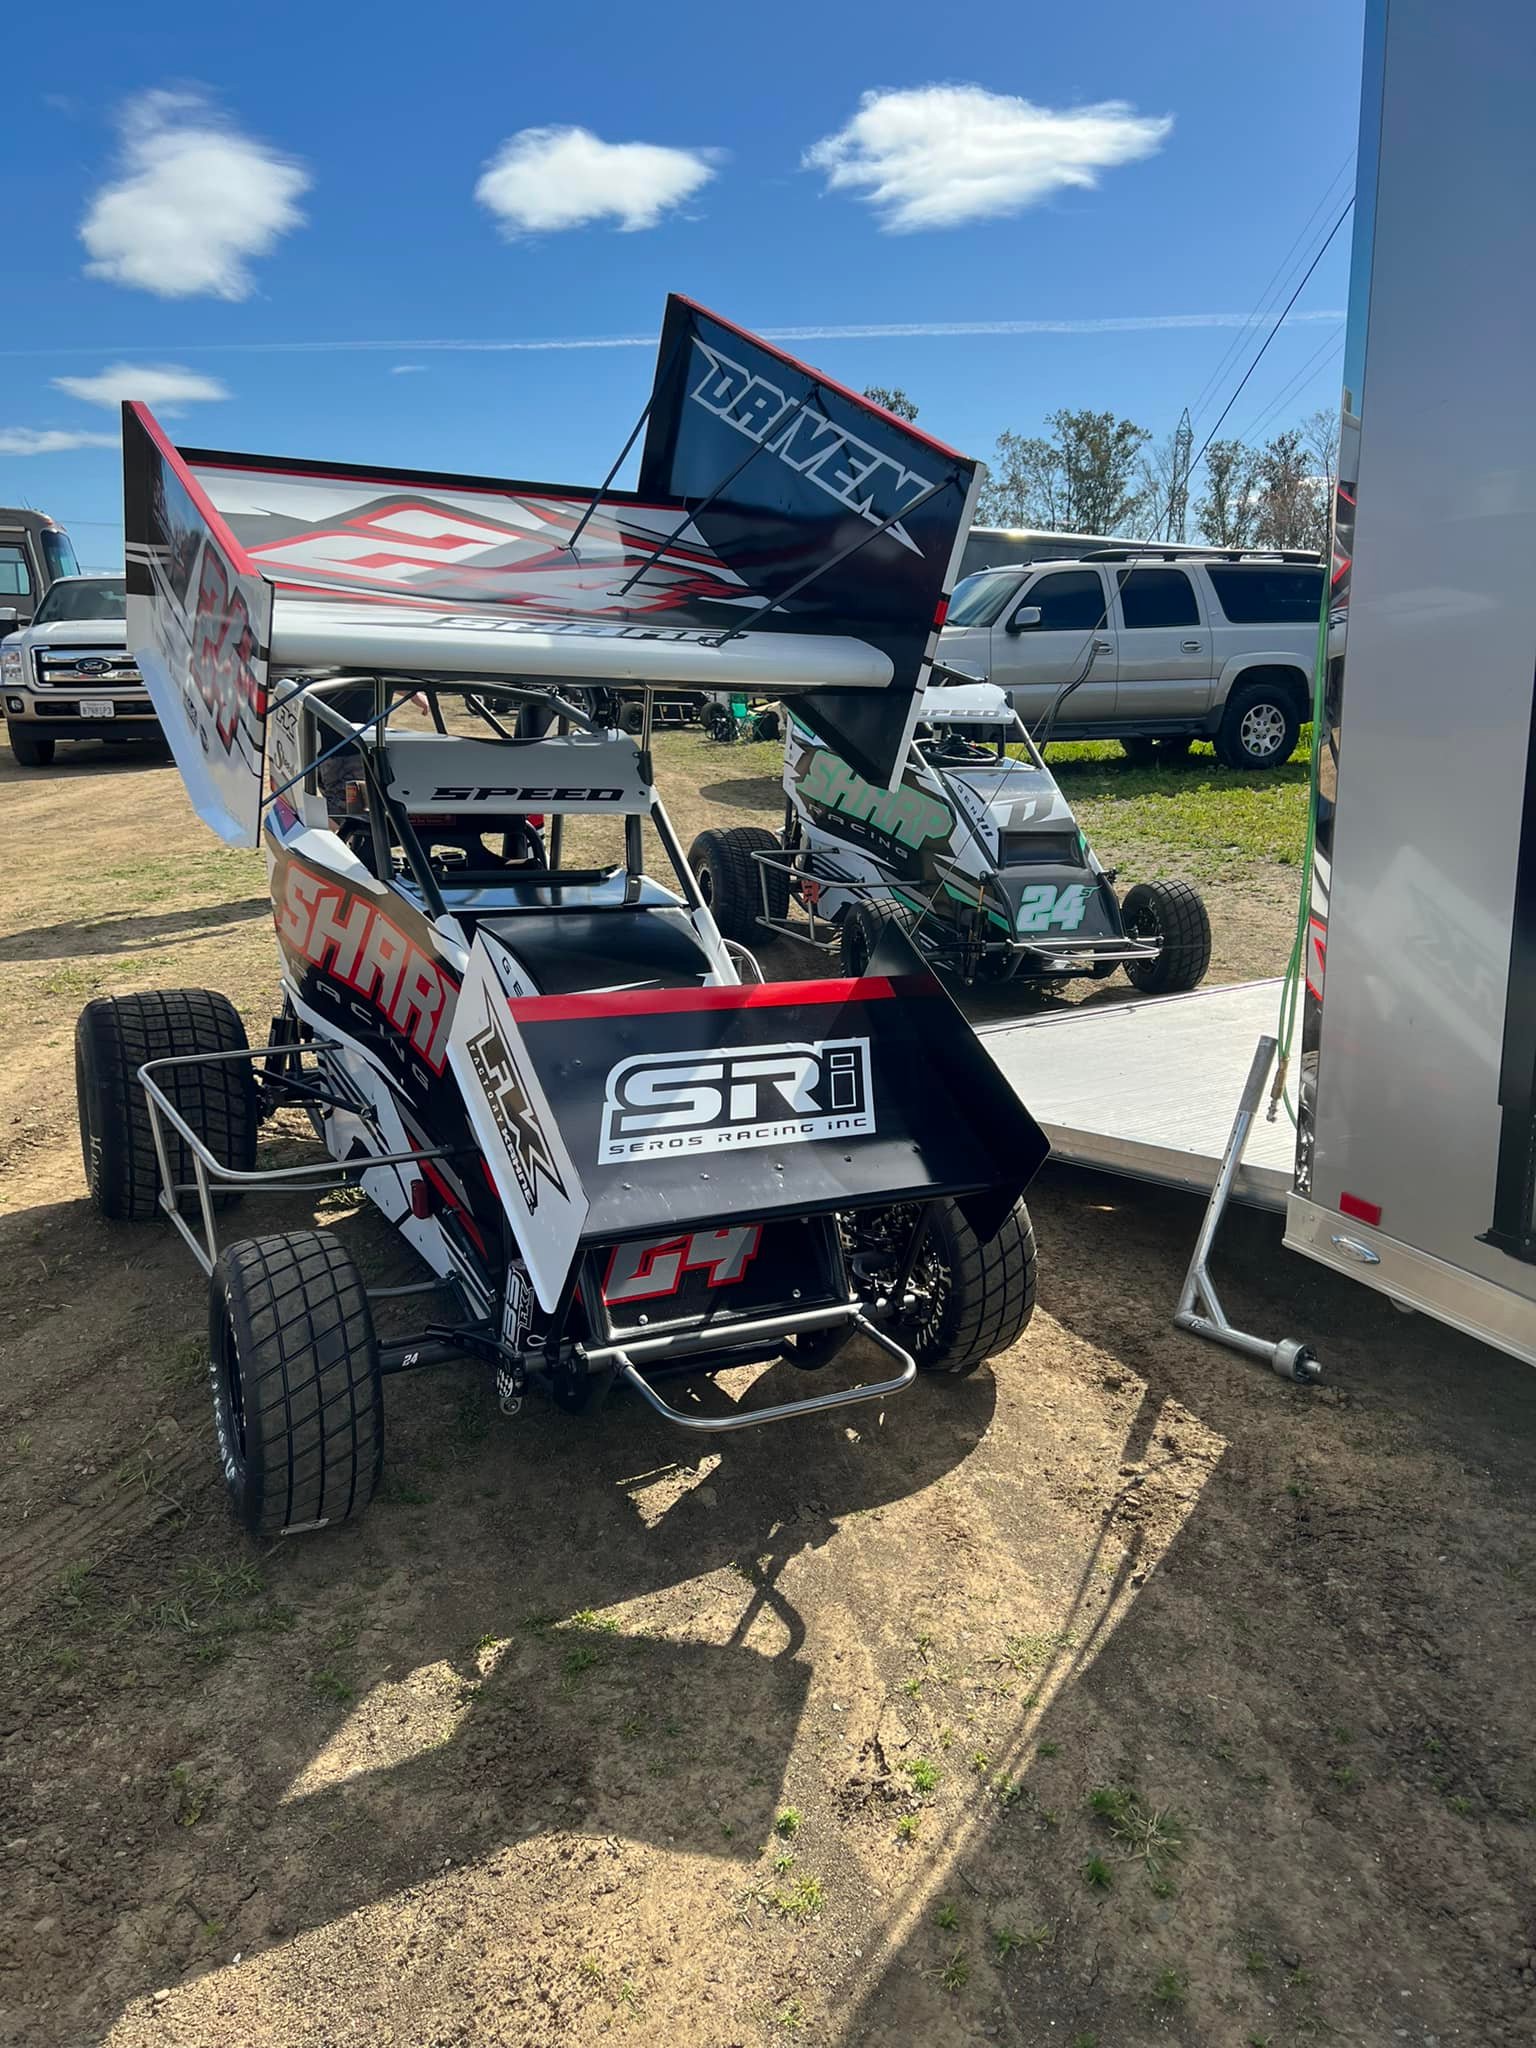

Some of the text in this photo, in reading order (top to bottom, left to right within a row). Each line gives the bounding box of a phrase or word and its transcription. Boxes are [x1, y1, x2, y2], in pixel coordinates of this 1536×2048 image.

[690, 335, 936, 559] DRIVEN
[429, 786, 625, 802] SPEED
[795, 750, 954, 850] SHARP
[808, 802, 909, 860] RACING
[289, 957, 430, 1092] RACING
[468, 1043, 534, 1210] FACTORY KAHNE
[609, 1135, 703, 1155] SEROS
[402, 1351, 420, 1367] 24
